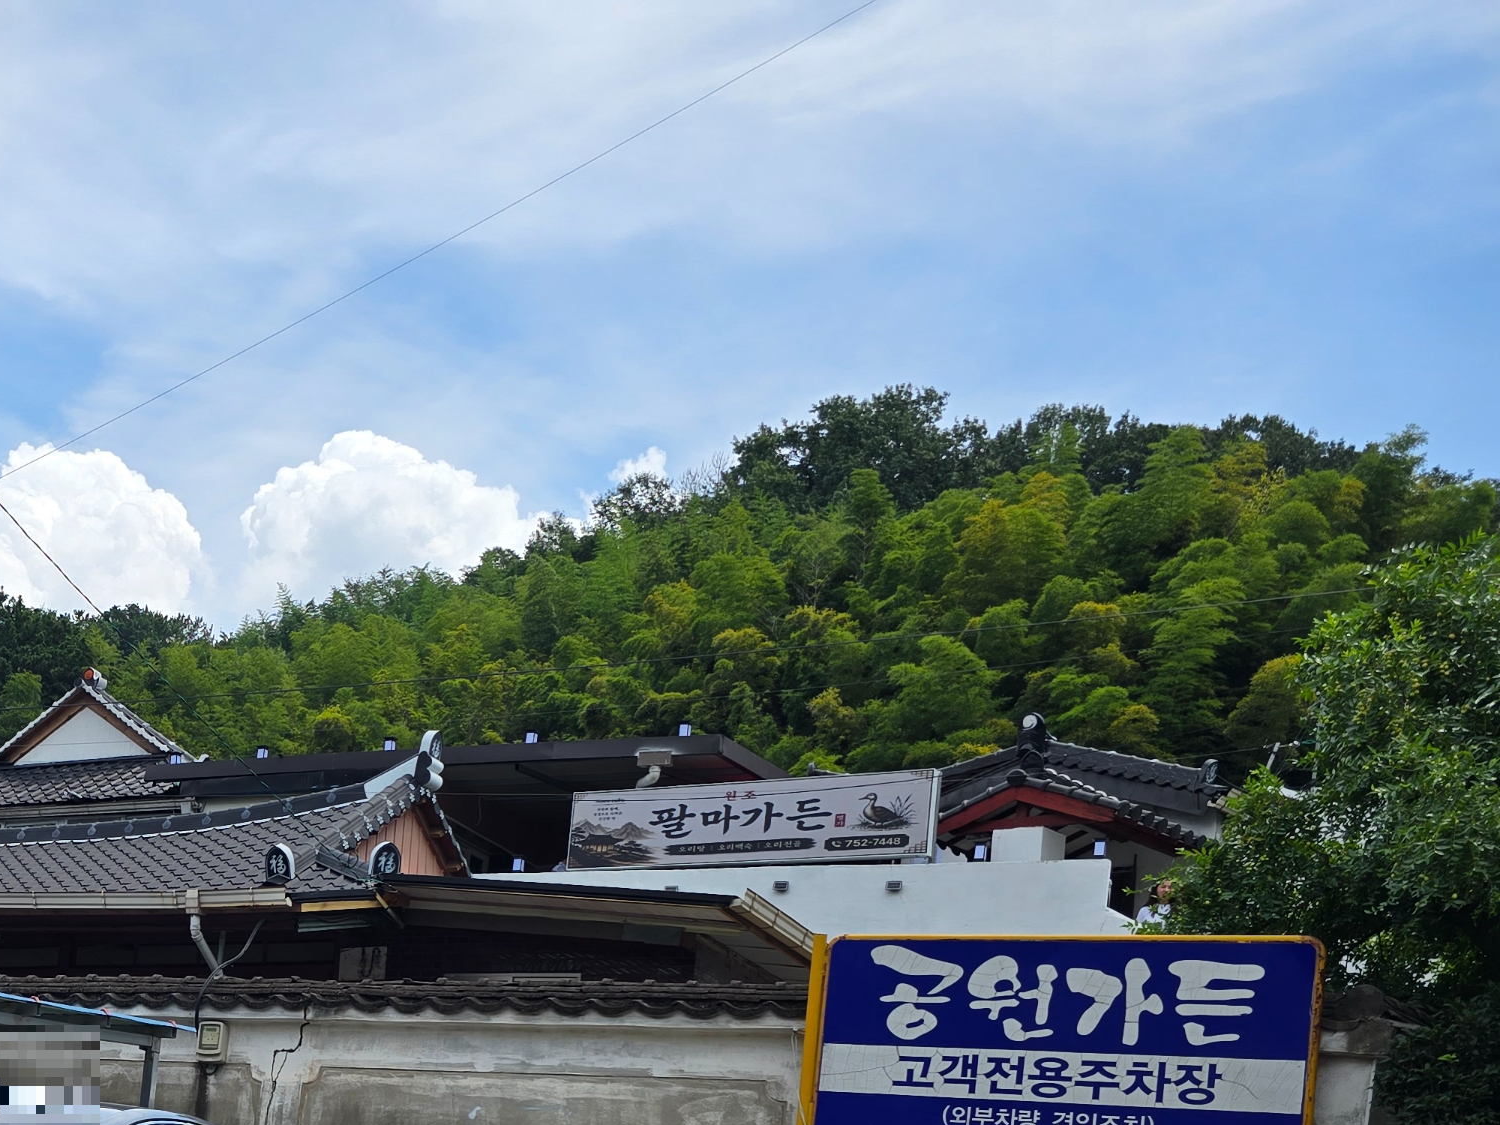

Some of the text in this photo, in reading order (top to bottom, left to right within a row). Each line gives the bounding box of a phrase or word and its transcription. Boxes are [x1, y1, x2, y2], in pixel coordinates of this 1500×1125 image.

[648, 798, 833, 839] 팔마가든
[678, 840, 802, 853] 오리탕 오리백숙 오리전골
[845, 837, 901, 848] 752-7448
[870, 944, 1266, 1047] 공원가든
[891, 1054, 1223, 1106] 고객전용주차장
